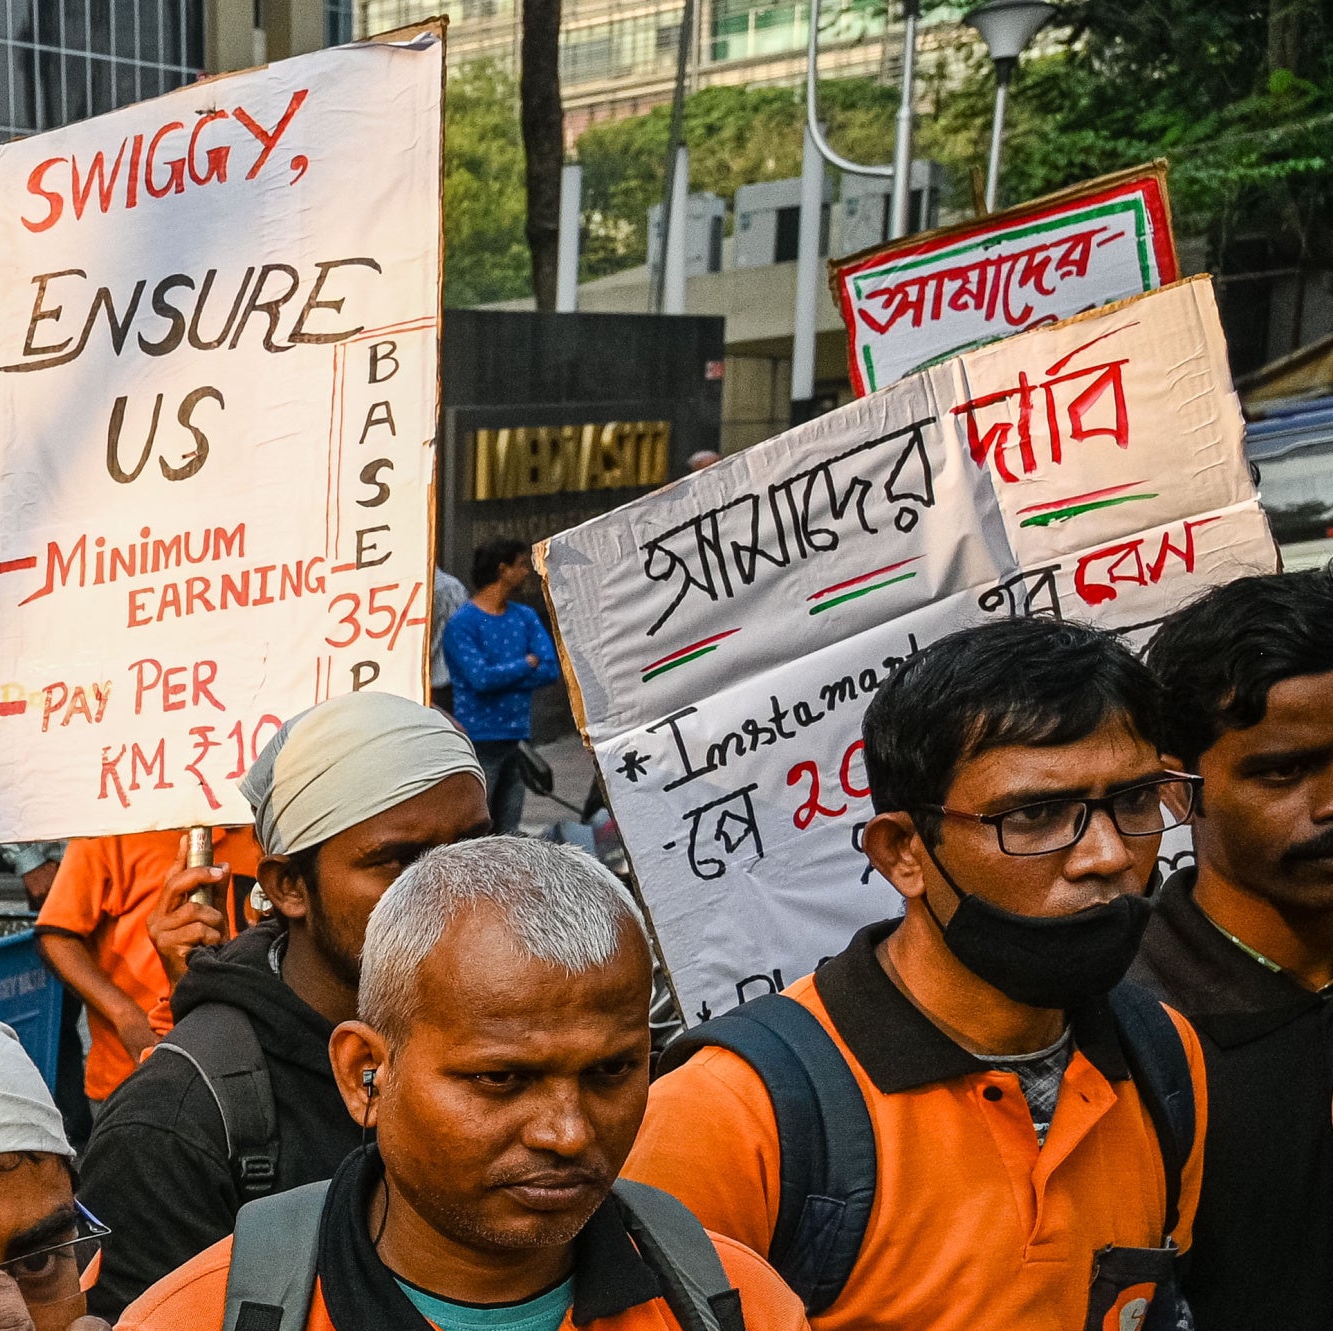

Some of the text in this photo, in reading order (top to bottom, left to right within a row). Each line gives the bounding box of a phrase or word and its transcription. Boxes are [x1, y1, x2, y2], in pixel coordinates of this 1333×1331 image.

[19, 88, 311, 234] SWIGGY,
[106, 387, 226, 484] US
[949, 321, 1141, 484] দাবি
[355, 341, 400, 571] BASE
[127, 556, 327, 629] EARNING
[41, 679, 113, 733] PAY
[128, 657, 228, 715] PER
[96, 738, 175, 809] KM
